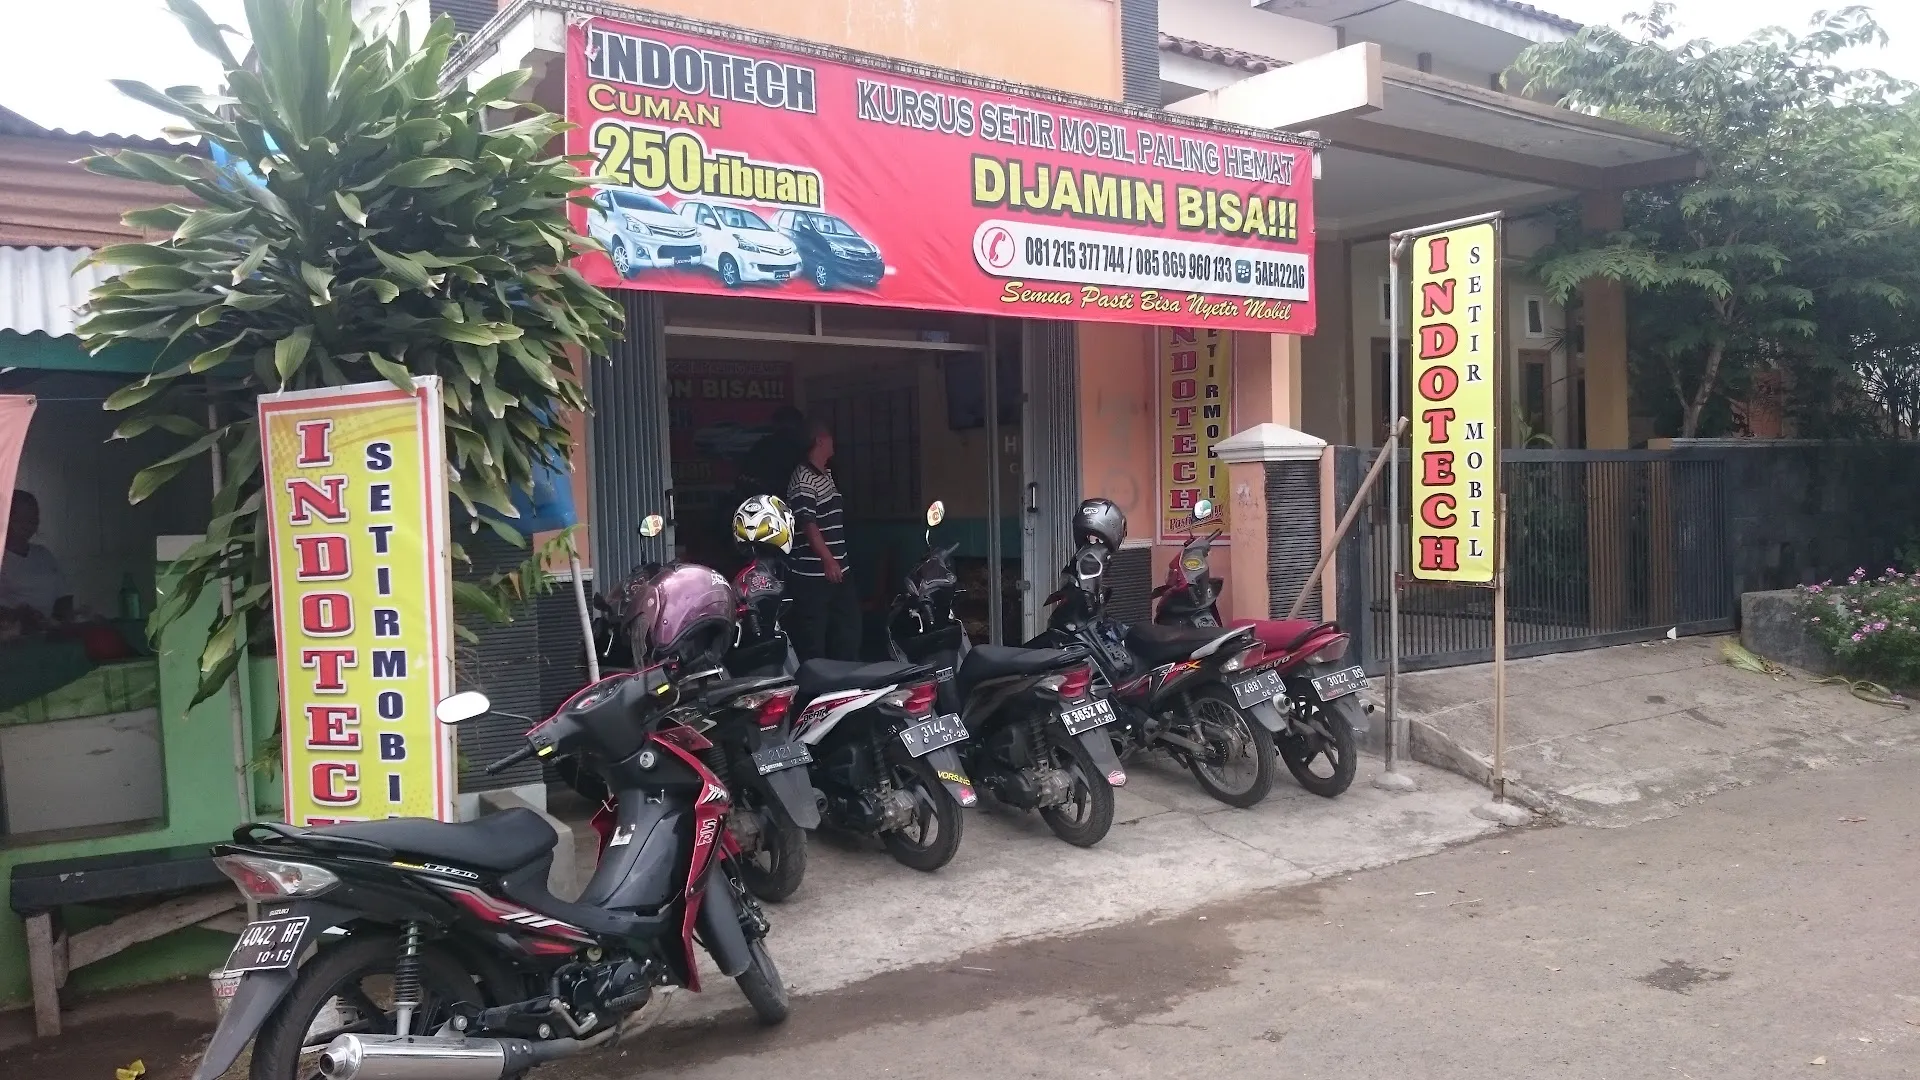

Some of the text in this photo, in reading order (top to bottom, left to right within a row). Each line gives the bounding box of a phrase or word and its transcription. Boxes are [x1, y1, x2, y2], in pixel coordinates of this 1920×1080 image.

[587, 83, 721, 128] CUMAN
[589, 30, 816, 113] INDOTECH
[857, 79, 1295, 186] KURSUS SETIR MOBIL PALING HEMAT
[972, 154, 1298, 240] DIJAMIN BISA!!!
[1025, 236, 1050, 266] 081
[1053, 239, 1076, 270] 215
[1078, 242, 1100, 272] 377
[1101, 244, 1124, 275] 744
[1135, 247, 1159, 278] 085
[1161, 250, 1186, 281] 869
[1188, 253, 1211, 282] 960
[1213, 256, 1232, 284] 133
[1255, 261, 1305, 290] 5AEA22A6
[1000, 280, 1292, 322] Semua Pasti Bisa Nyetir Mobil
[1169, 327, 1201, 511] NDOTECH
[1418, 237, 1459, 571] INDOTECH
[1465, 246, 1484, 557] SETIR MOBIL
[284, 418, 365, 826] INDOTEC
[1094, 701, 1109, 715] KV
[1327, 672, 1349, 687] 3022
[904, 716, 960, 744] R 3144 P
[243, 921, 304, 947] 4042 HF
